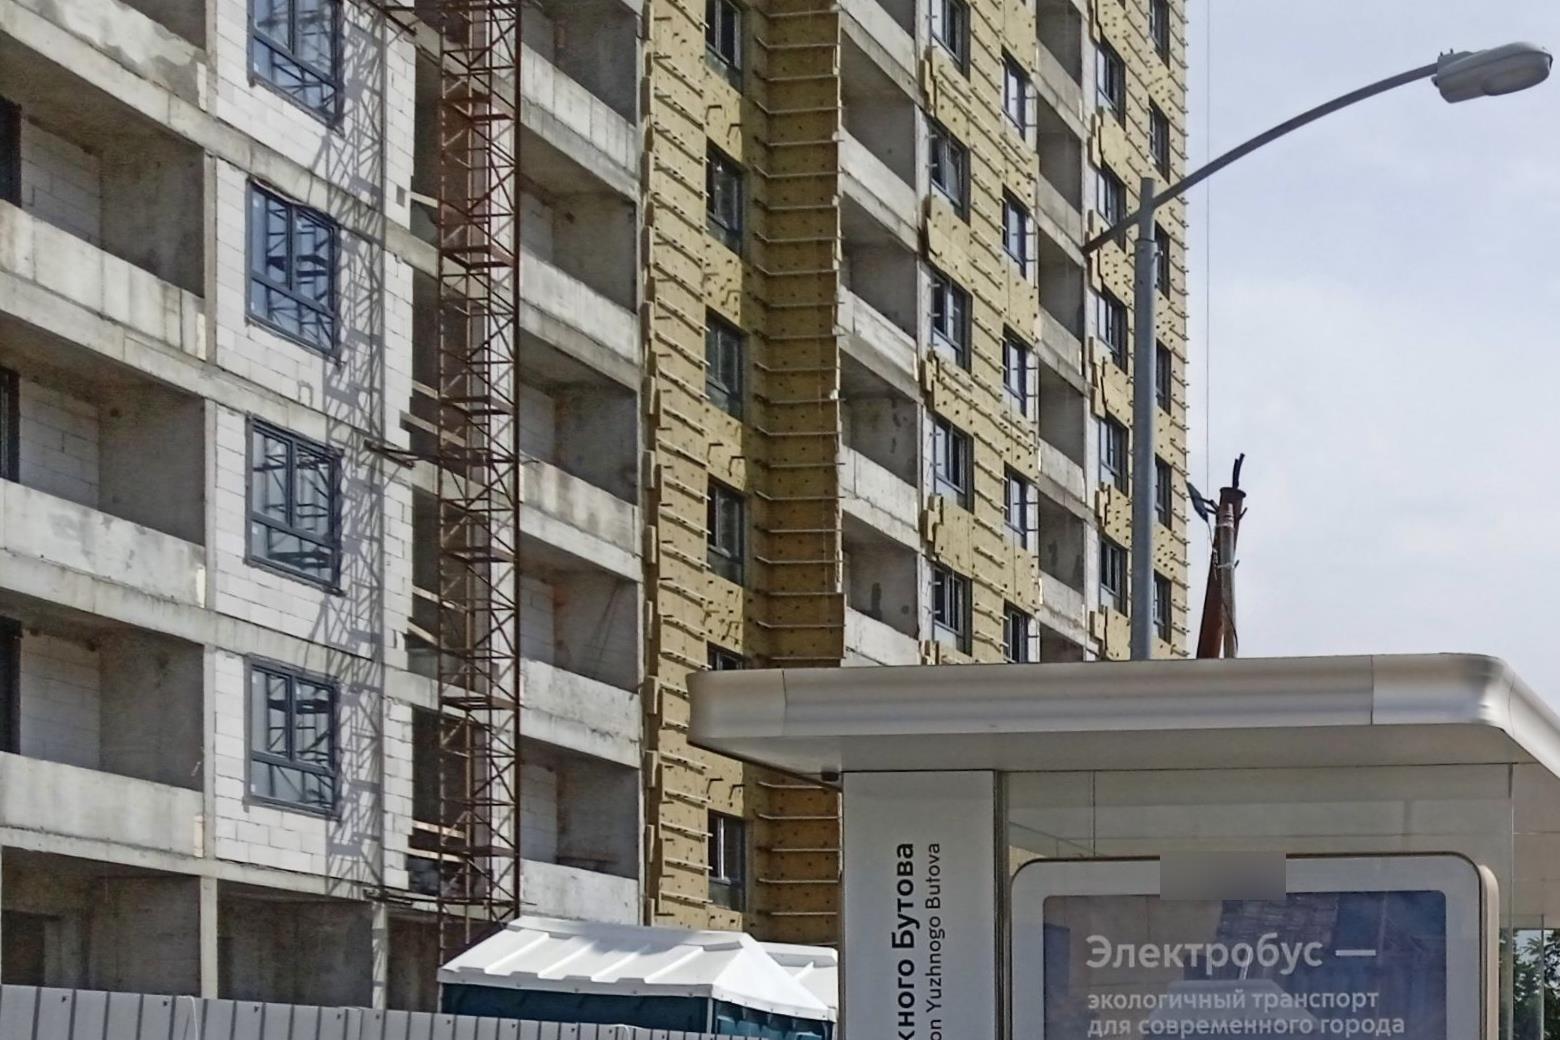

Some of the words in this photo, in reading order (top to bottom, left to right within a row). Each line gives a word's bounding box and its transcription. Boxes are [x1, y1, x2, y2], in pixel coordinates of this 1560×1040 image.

[891, 843, 920, 949] Бутова
[924, 843, 941, 909] Butova
[924, 916, 945, 1013] Yuzhnogo
[1085, 931, 1323, 975] Электробус
[1087, 988, 1246, 1010] экологичный
[1252, 991, 1379, 1014] транспорт
[1087, 1019, 1131, 1038] для
[1138, 1018, 1313, 1040] современного
[1320, 1017, 1405, 1039] города
